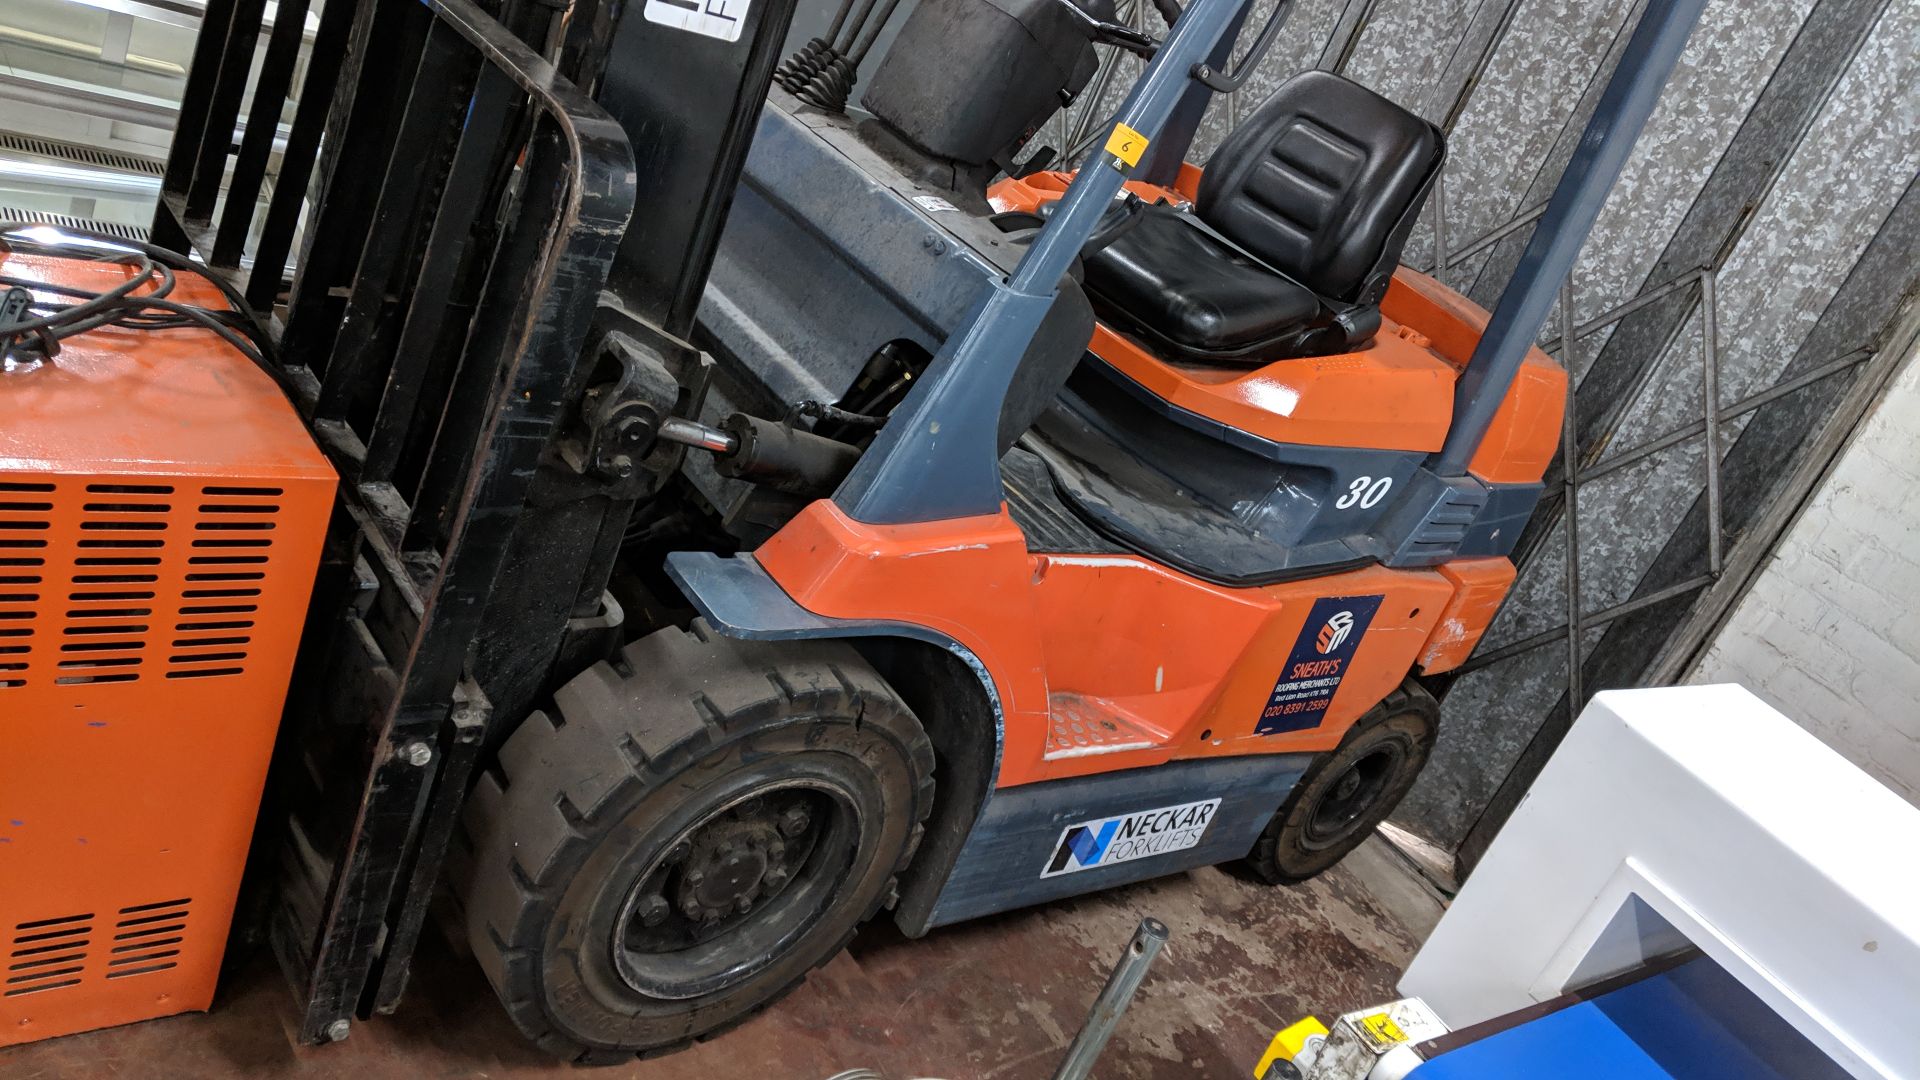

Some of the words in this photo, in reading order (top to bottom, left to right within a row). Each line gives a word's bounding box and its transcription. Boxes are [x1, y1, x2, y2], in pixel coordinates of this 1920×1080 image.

[1121, 141, 1133, 152] 6
[1336, 476, 1392, 509] 30
[1290, 659, 1341, 679] SNEATH'S
[1275, 682, 1300, 692] ROOFING
[1299, 678, 1330, 689] MERCHANTS
[1329, 677, 1340, 686] LTD
[1265, 705, 1283, 718] 020
[1283, 702, 1306, 715] 8391
[1306, 699, 1329, 711] 2599
[1117, 803, 1214, 840] NECKAR
[1105, 827, 1202, 862] FORKLIFTS
